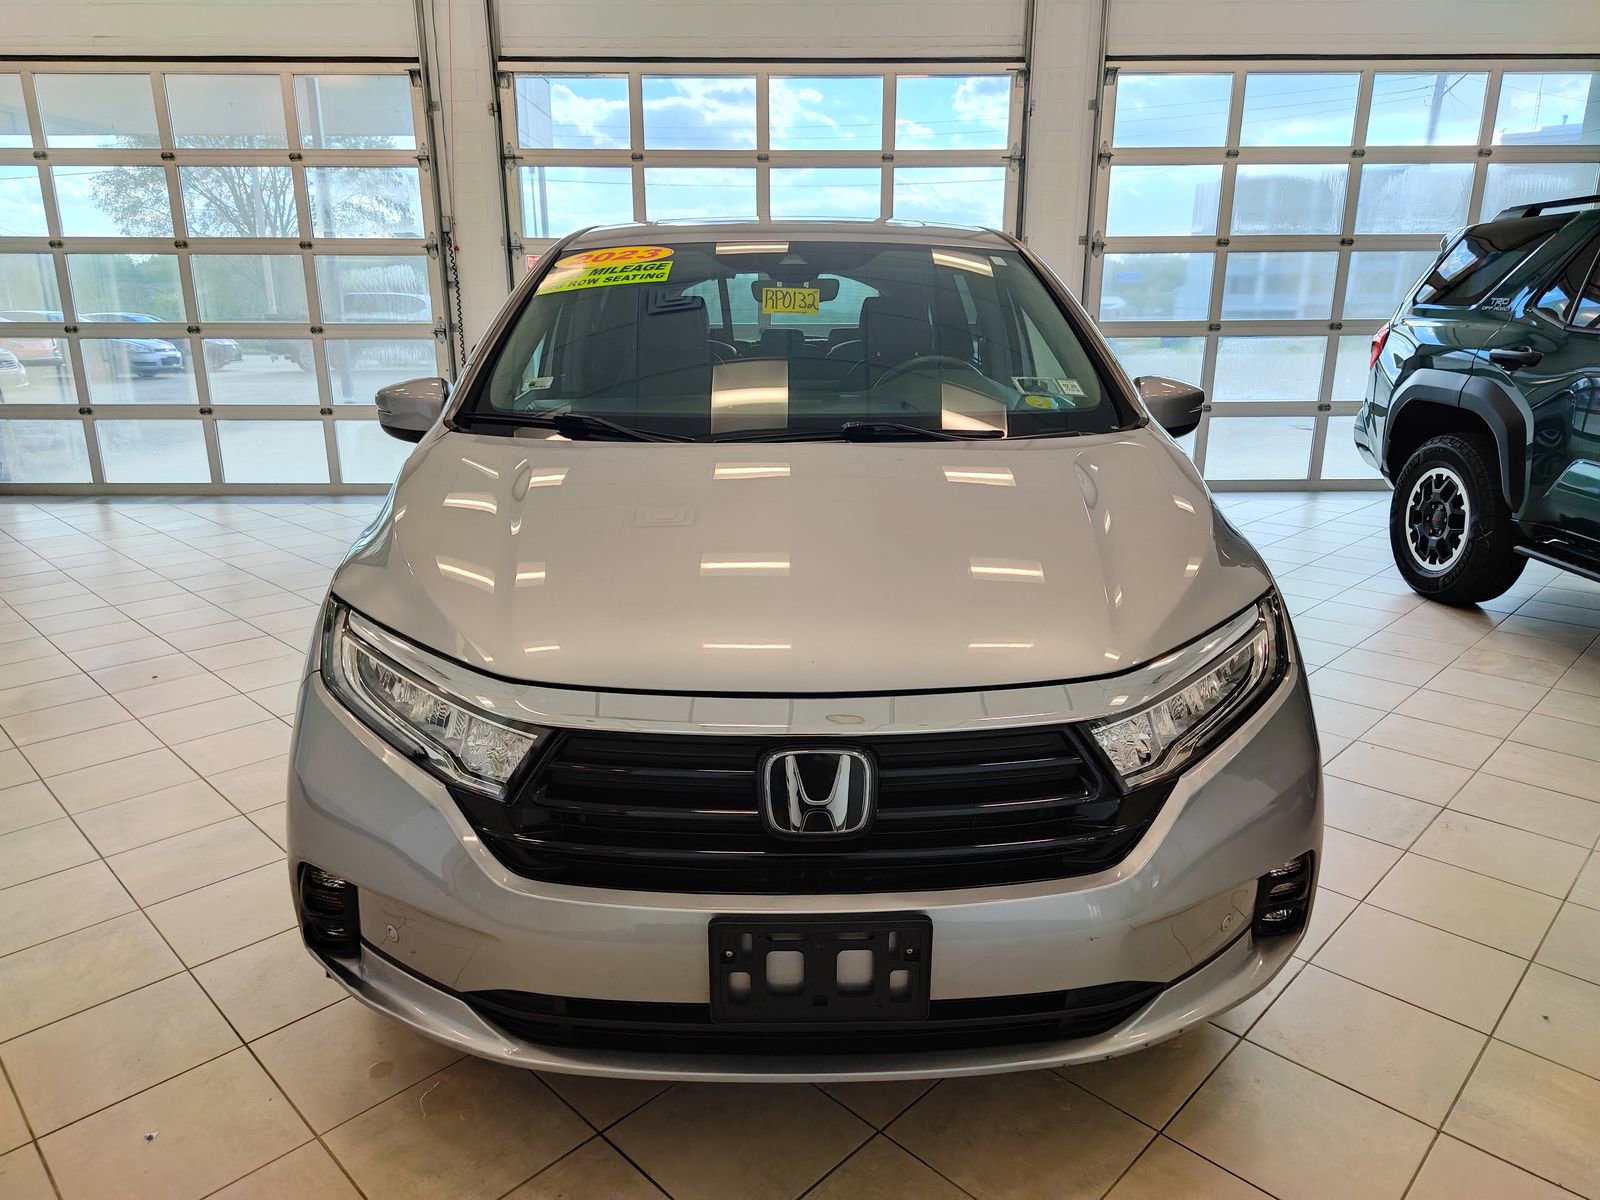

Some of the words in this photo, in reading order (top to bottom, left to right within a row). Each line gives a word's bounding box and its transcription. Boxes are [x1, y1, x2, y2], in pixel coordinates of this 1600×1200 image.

[568, 248, 663, 265] 2023
[588, 261, 670, 276] MILEAGE
[568, 278, 600, 288] ROW
[603, 271, 666, 283] SEATING
[1491, 297, 1510, 306] TRD
